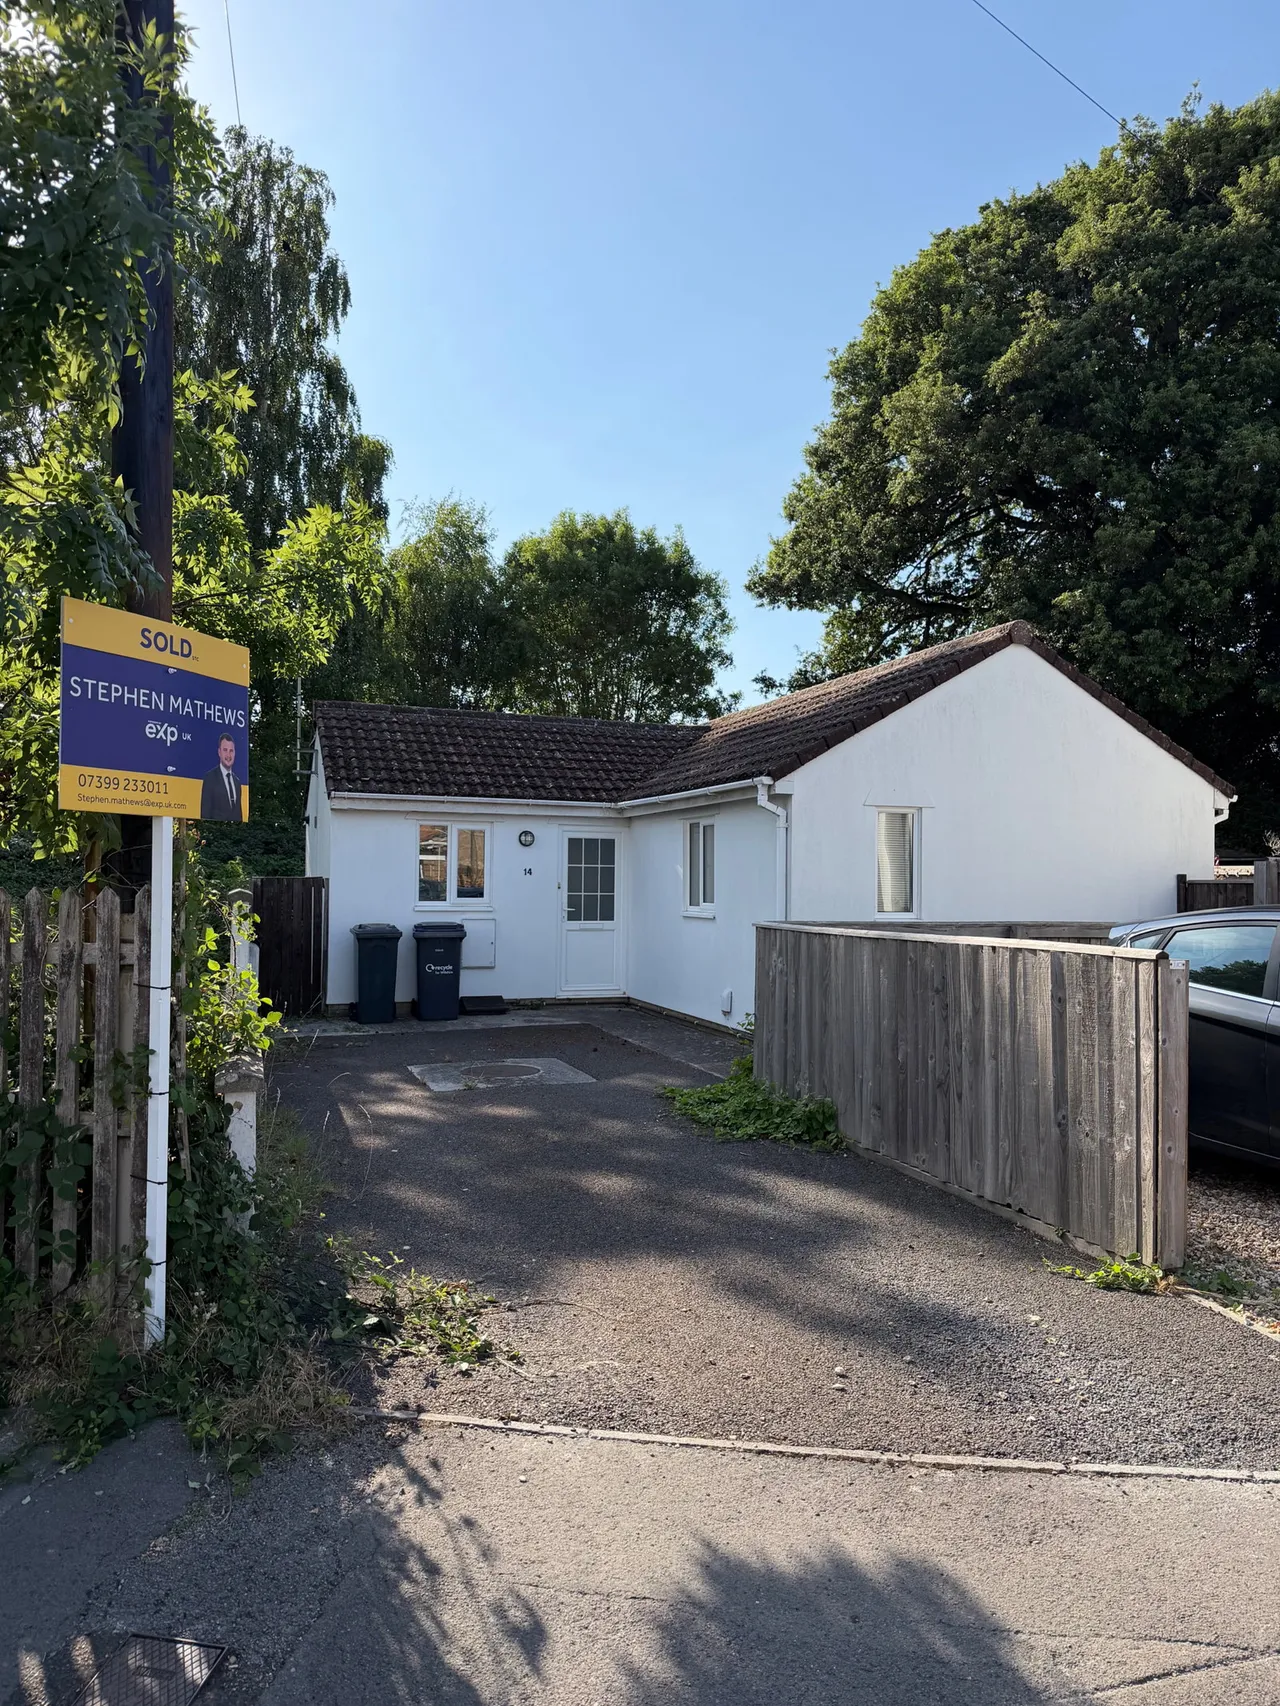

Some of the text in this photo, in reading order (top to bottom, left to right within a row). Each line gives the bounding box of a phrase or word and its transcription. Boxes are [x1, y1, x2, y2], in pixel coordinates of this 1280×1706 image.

[140, 627, 192, 658] SOLD
[69, 676, 245, 728] STEPHEN MATHEWS
[145, 723, 192, 747] exp UK
[78, 773, 169, 794] 07399 233011
[77, 793, 187, 809] Stephen.mathews@exp.uk.com
[523, 867, 533, 876] 14
